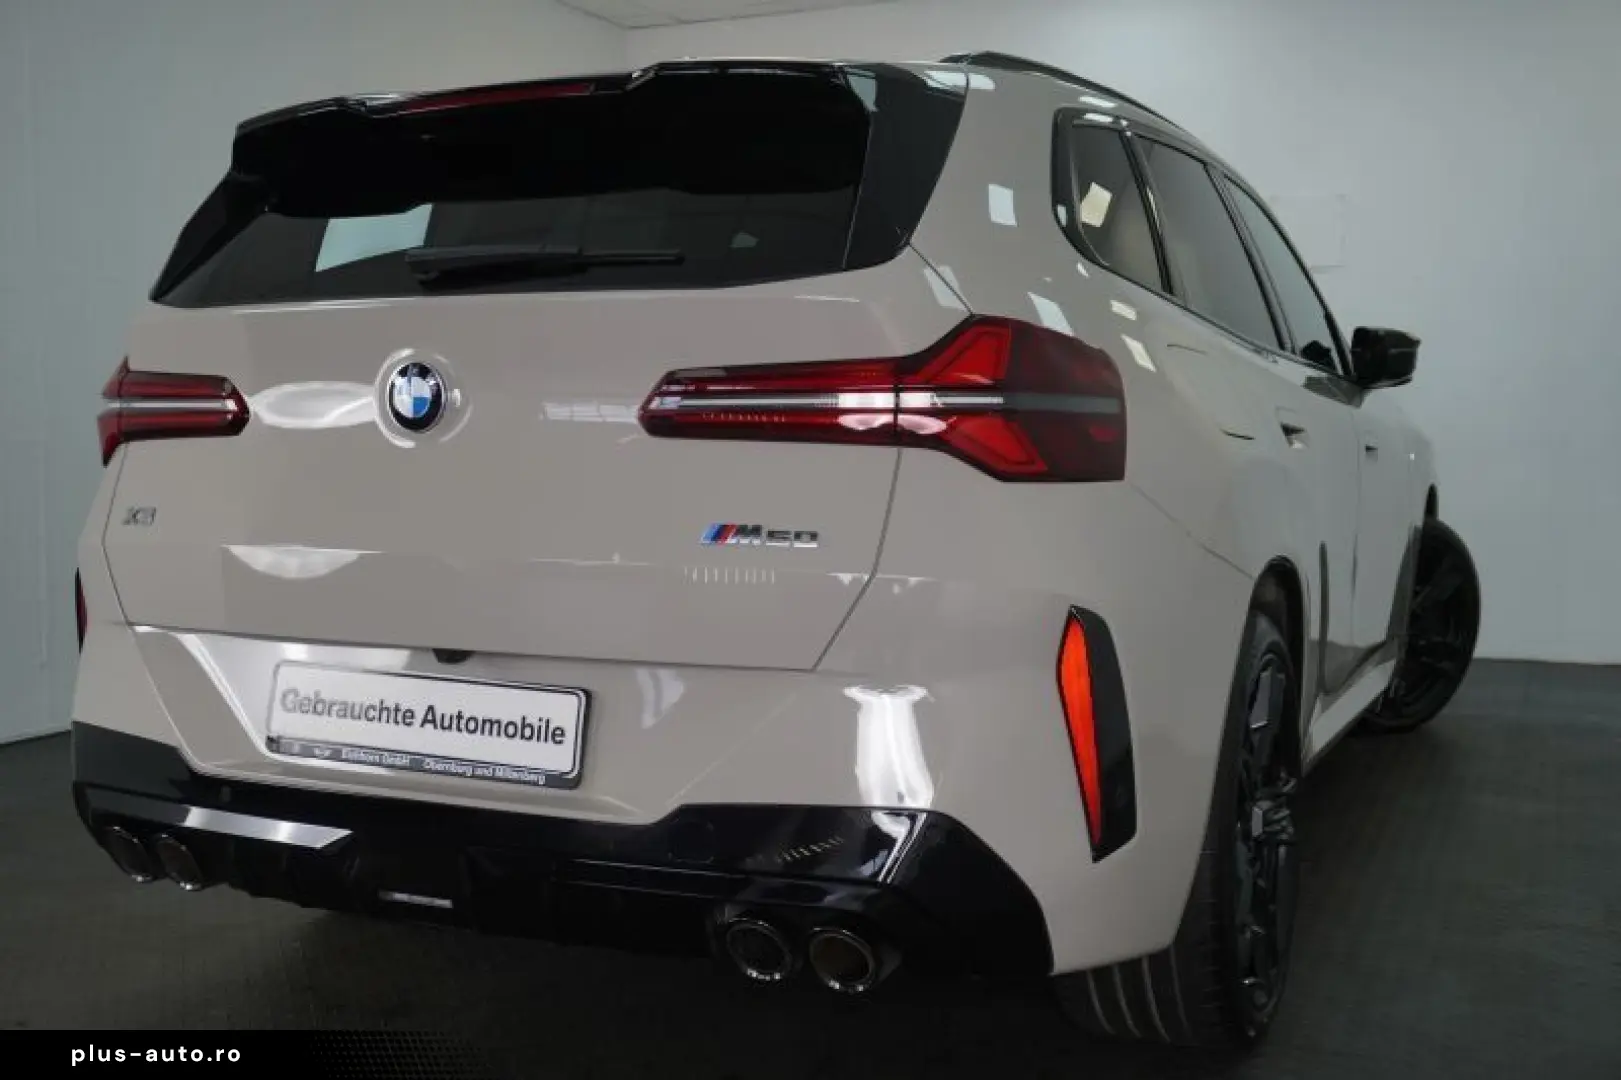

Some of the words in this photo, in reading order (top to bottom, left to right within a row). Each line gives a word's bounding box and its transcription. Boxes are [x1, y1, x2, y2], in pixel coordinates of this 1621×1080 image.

[121, 506, 157, 527] X3
[722, 523, 819, 548] M50
[279, 688, 414, 727] Gebrauchte
[419, 704, 566, 745] Automobile
